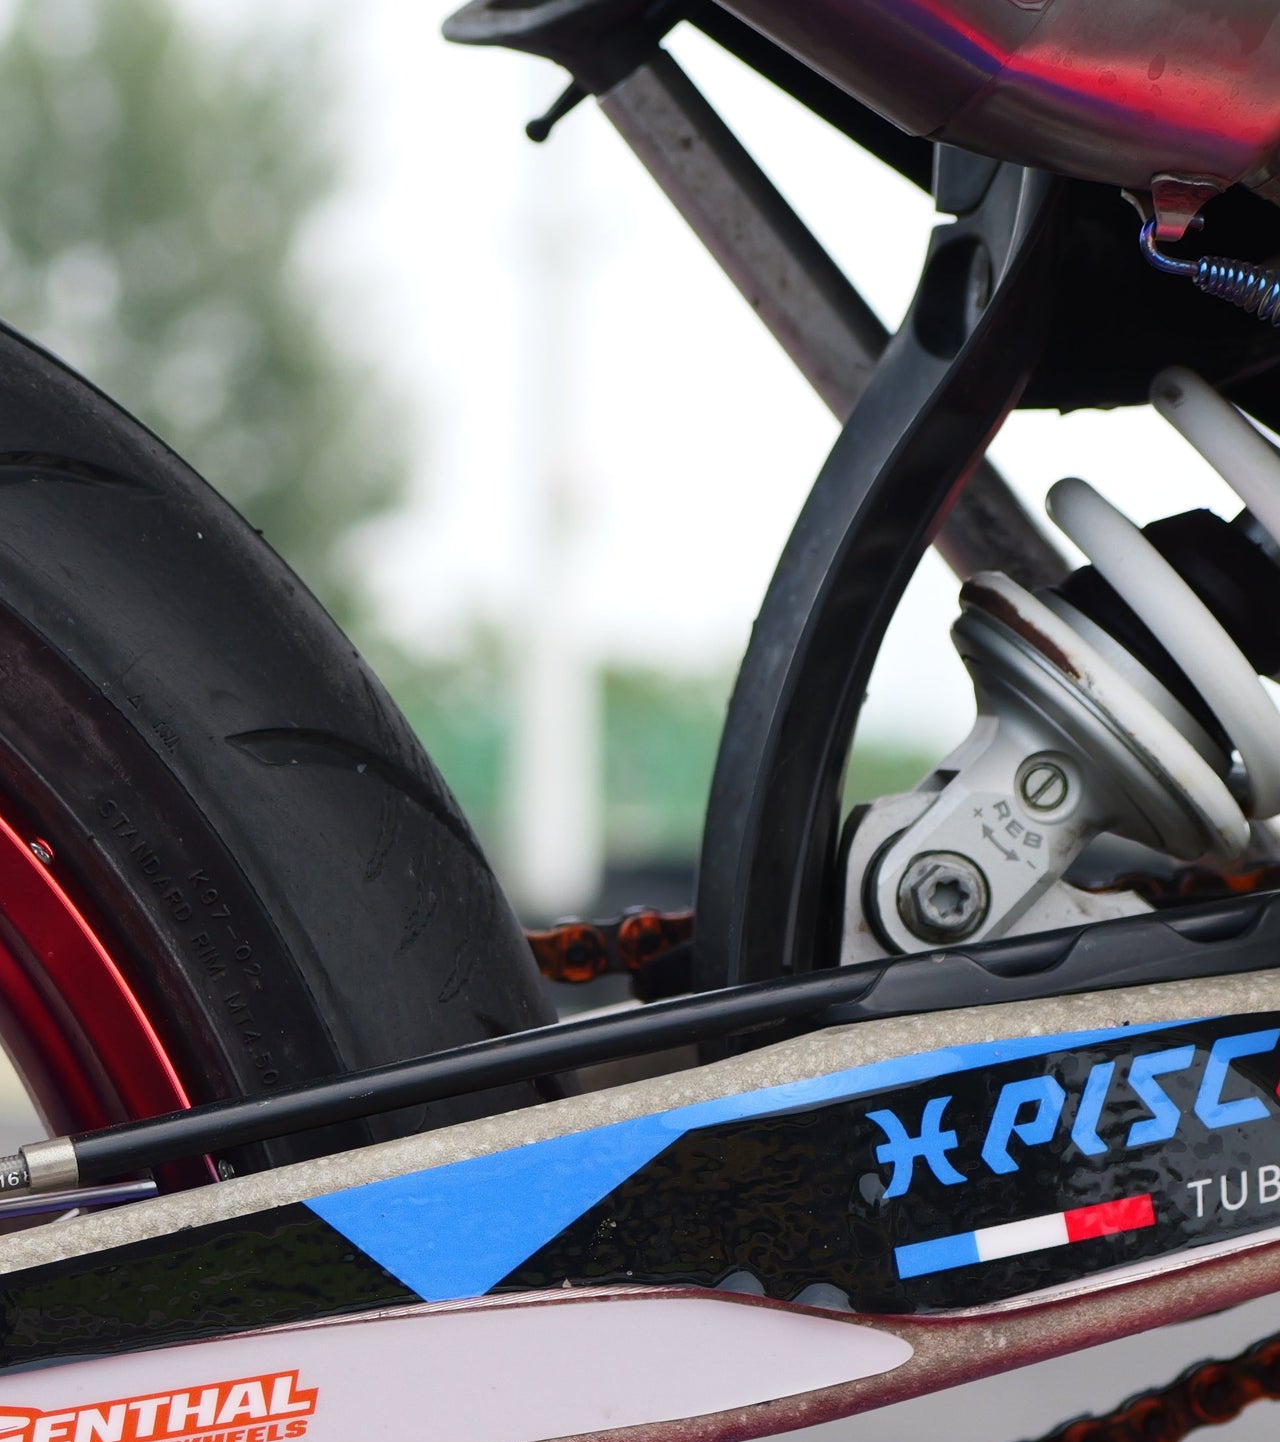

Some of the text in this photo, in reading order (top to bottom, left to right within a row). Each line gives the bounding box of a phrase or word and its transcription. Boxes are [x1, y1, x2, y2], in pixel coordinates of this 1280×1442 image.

[98, 799, 192, 923] STANDARD
[993, 800, 1043, 849] REB
[981, 1028, 1280, 1175] PISC
